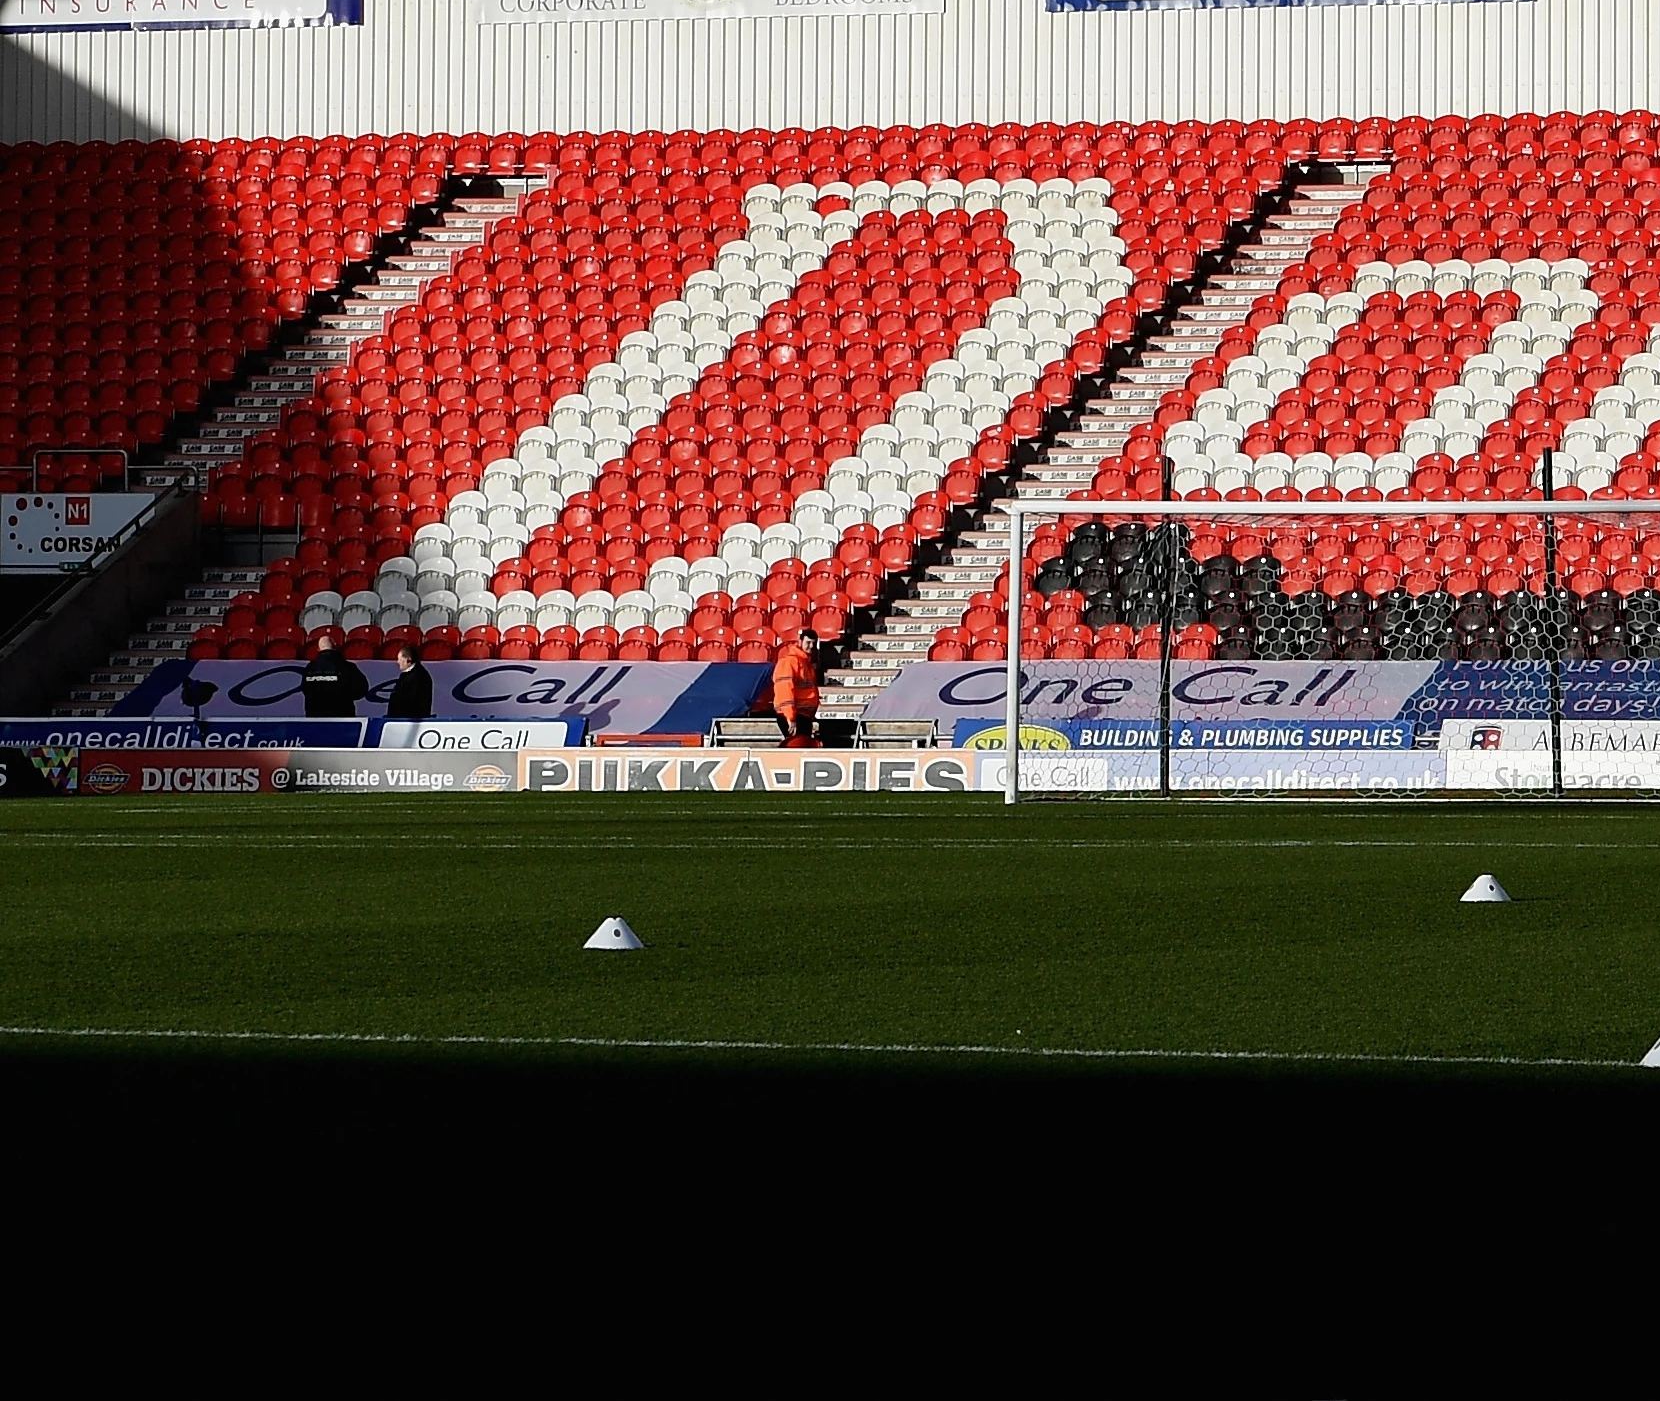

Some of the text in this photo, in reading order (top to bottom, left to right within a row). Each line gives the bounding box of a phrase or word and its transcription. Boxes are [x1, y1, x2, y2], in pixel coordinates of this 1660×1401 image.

[67, 502, 88, 520] N1
[40, 536, 121, 553] CORSAN
[1566, 659, 1601, 673] us
[1610, 659, 1649, 673] on
[451, 665, 632, 705] Call
[938, 666, 1356, 706] One Call
[1437, 677, 1470, 691] to
[1479, 676, 1537, 691] win
[1418, 697, 1459, 711] on
[417, 729, 529, 750] One Call
[974, 738, 1061, 750] SPKS
[1080, 729, 1403, 747] BUILDIN & PLUMBING SUPPLIES
[141, 767, 454, 793] DICKIES @ Lakeside Village
[526, 757, 967, 791] PUKKA-PIES
[1051, 766, 1092, 788] Call
